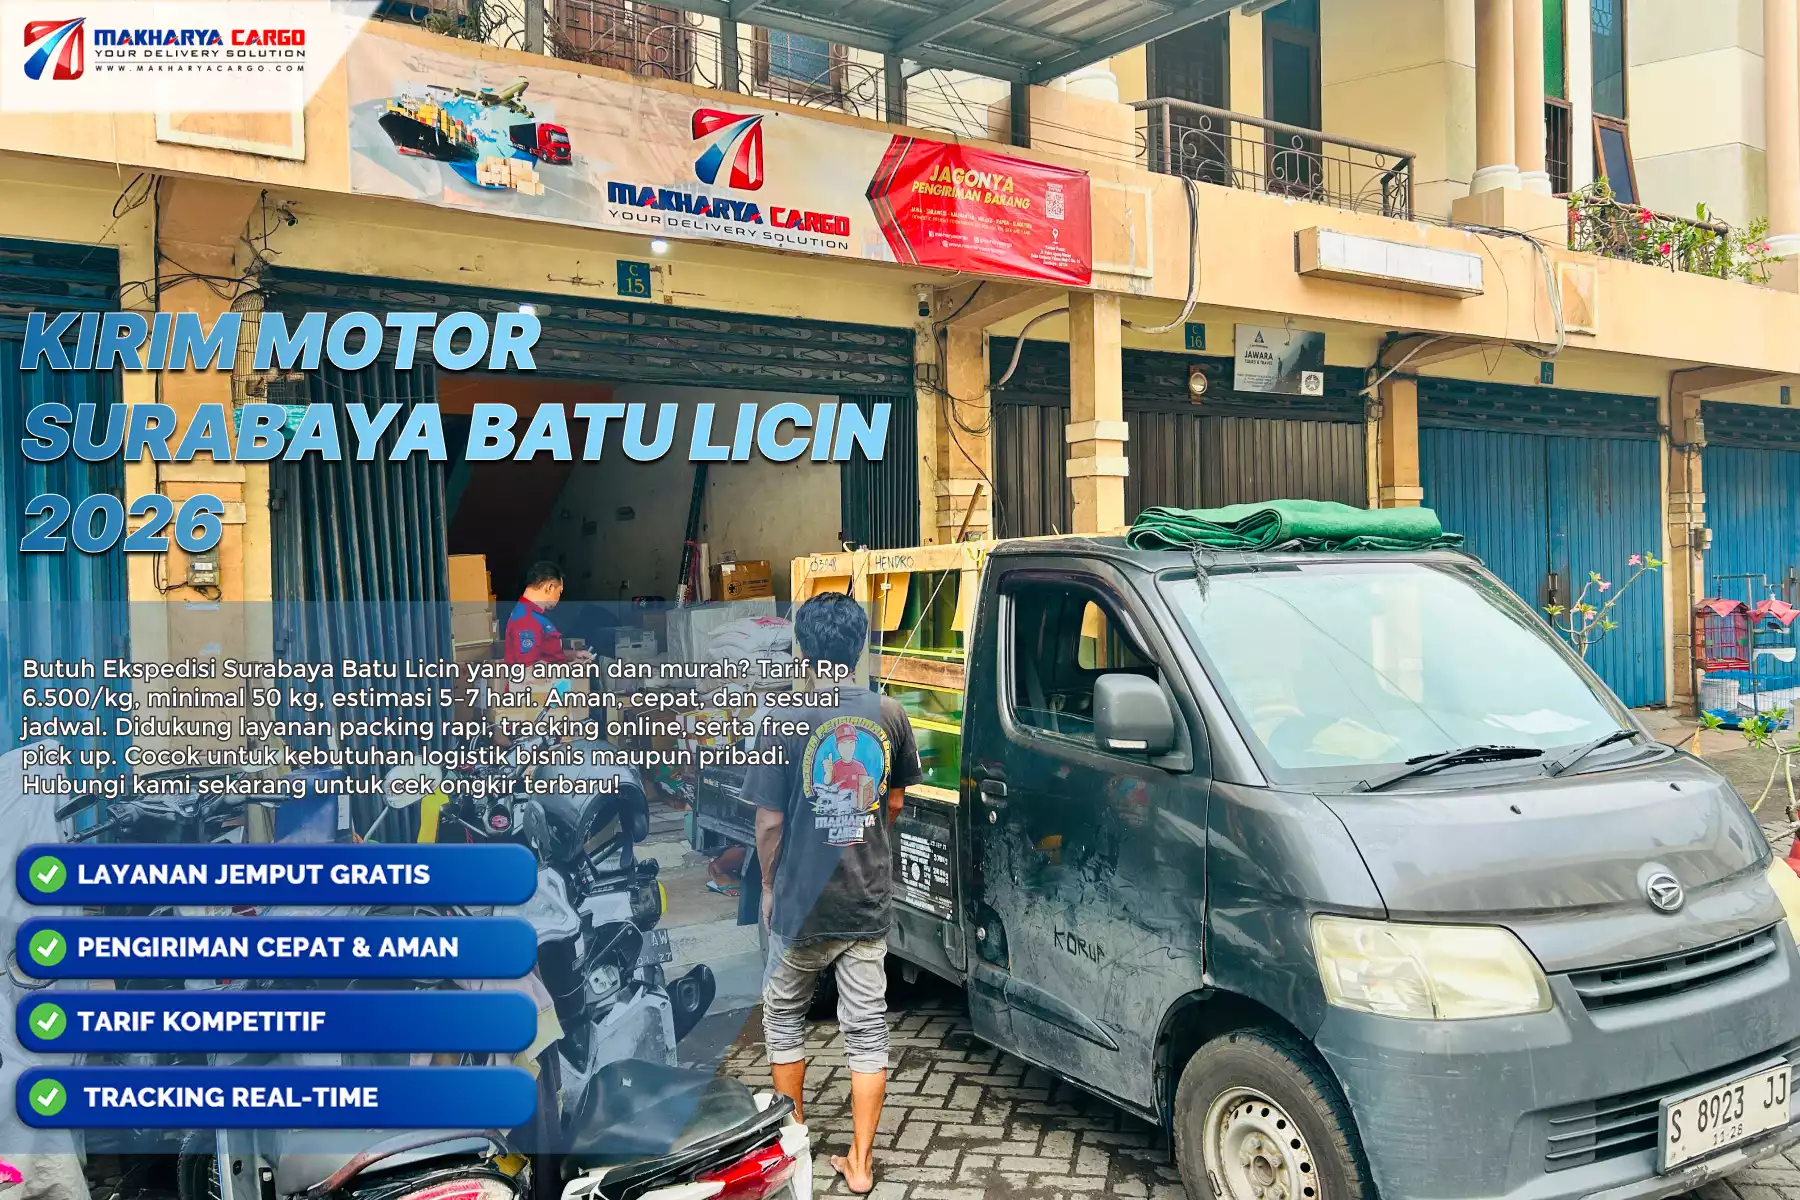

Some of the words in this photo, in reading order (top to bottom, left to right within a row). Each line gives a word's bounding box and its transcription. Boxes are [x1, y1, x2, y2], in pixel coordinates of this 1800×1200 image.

[929, 165, 1015, 193] JAGONYA
[607, 181, 763, 225] MAKHARYA
[769, 206, 850, 237] CARGO
[911, 181, 981, 202] PENGIRIMAN
[984, 192, 1030, 209] BARANG
[608, 209, 661, 225] YOUR
[667, 217, 757, 238] DELIVERY
[762, 231, 849, 250] SOLUTION
[628, 264, 639, 278] C
[626, 277, 645, 295] 15
[1191, 335, 1203, 348] 16
[1244, 351, 1274, 361] JAWARA
[1671, 1109, 1682, 1143] S
[1697, 1086, 1744, 1132] 8923
[1764, 1073, 1786, 1108] JJ
